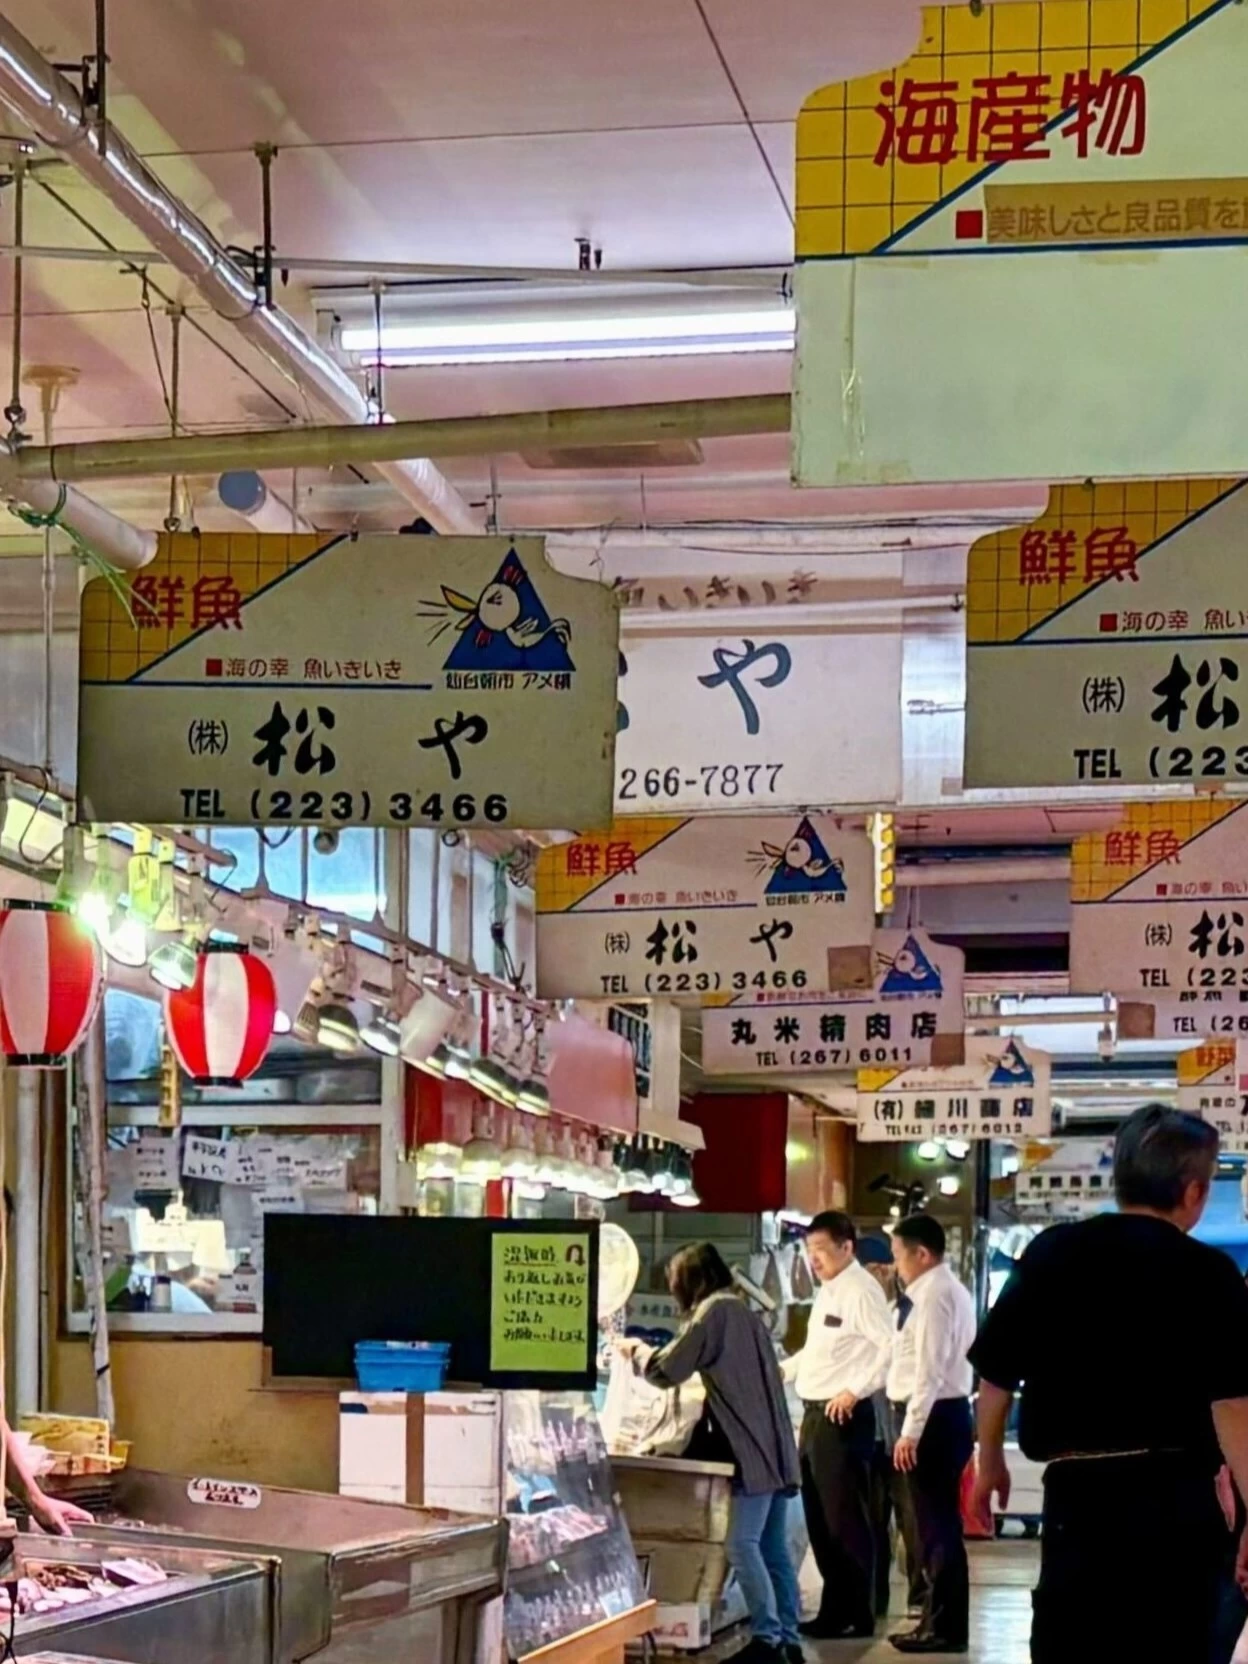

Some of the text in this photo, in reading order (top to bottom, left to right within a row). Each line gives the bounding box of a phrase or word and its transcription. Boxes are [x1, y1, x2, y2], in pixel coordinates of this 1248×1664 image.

[873, 67, 1145, 166] 海産物
[1019, 526, 1140, 585] 鮮魚
[132, 575, 243, 632] 鮮魚
[1121, 610, 1188, 632] 海の幸
[226, 656, 402, 681] 海の幸 魚いきいき
[446, 672, 572, 690] 仙台朝市 アメ横
[1074, 748, 1121, 779] TEL
[619, 764, 783, 799] 266-7877
[182, 790, 225, 818] TEL
[566, 841, 637, 876] 鮮魚
[1104, 830, 1181, 866] 鮮魚
[601, 976, 629, 992] TEL
[1140, 969, 1170, 987] TEL
[731, 1012, 937, 1044] 丸米精肉店
[1174, 1017, 1196, 1032] TEL
[756, 1051, 779, 1065] TEL
